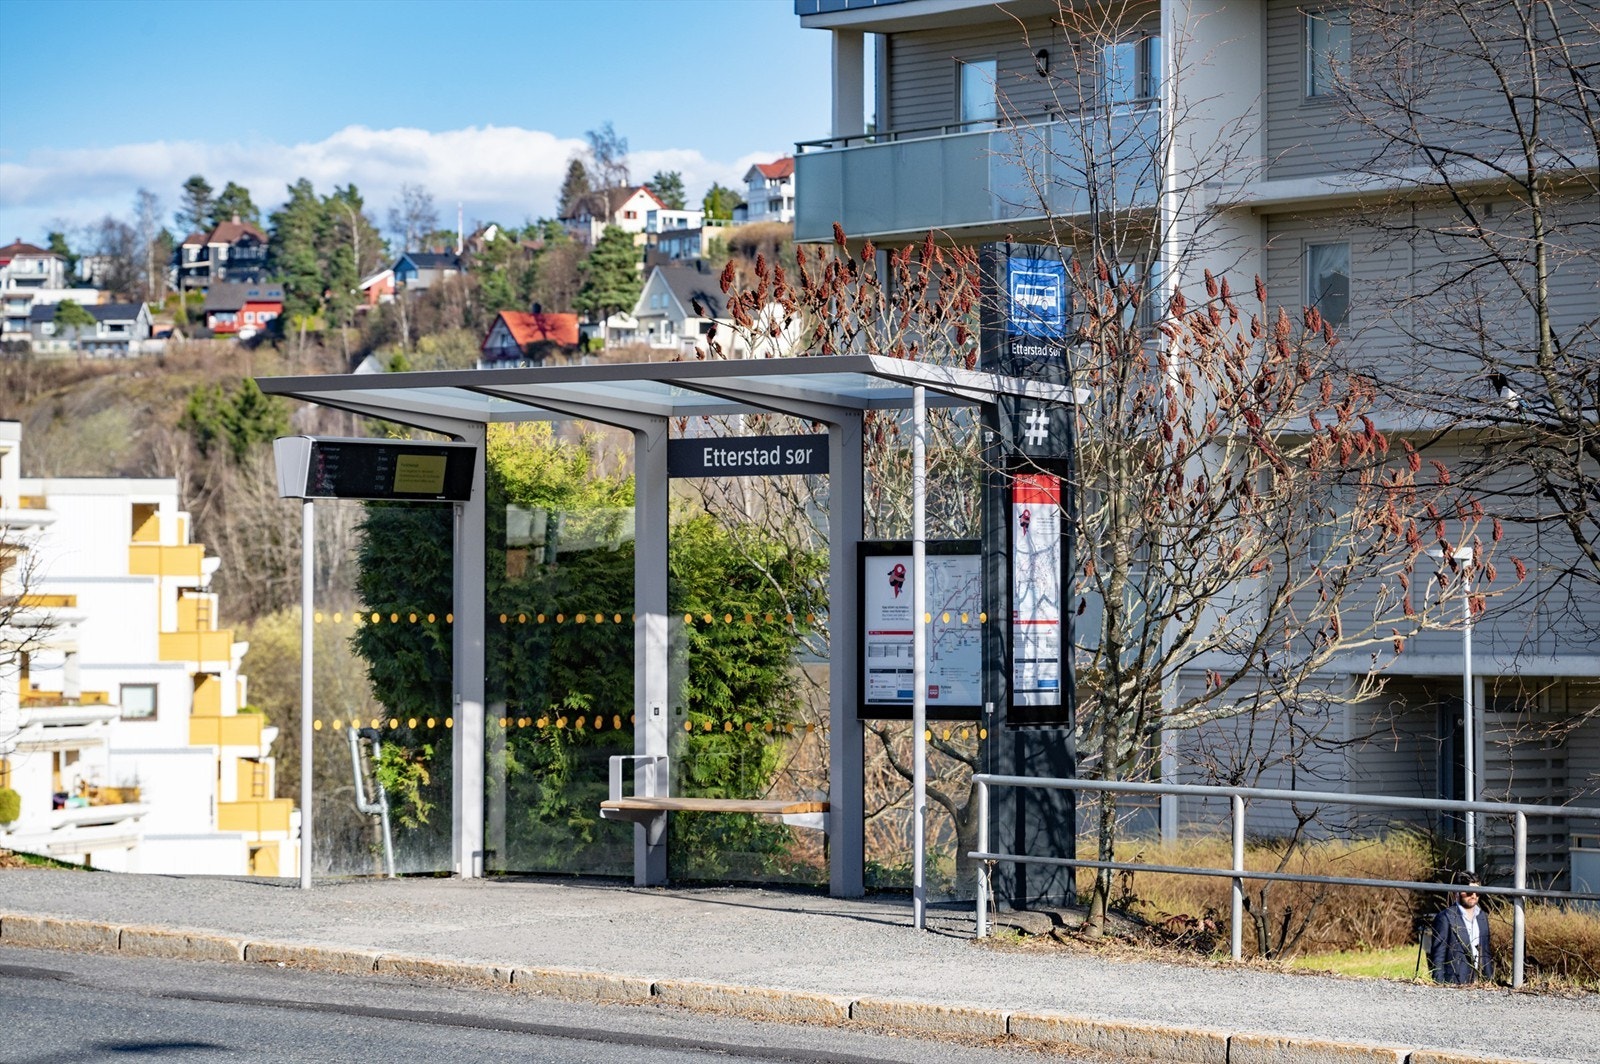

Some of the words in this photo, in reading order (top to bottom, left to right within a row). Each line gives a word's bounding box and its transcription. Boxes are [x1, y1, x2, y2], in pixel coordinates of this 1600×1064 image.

[1011, 342, 1048, 357] Etterstad
[703, 445, 780, 467] Etterstad
[785, 448, 813, 465] sør
